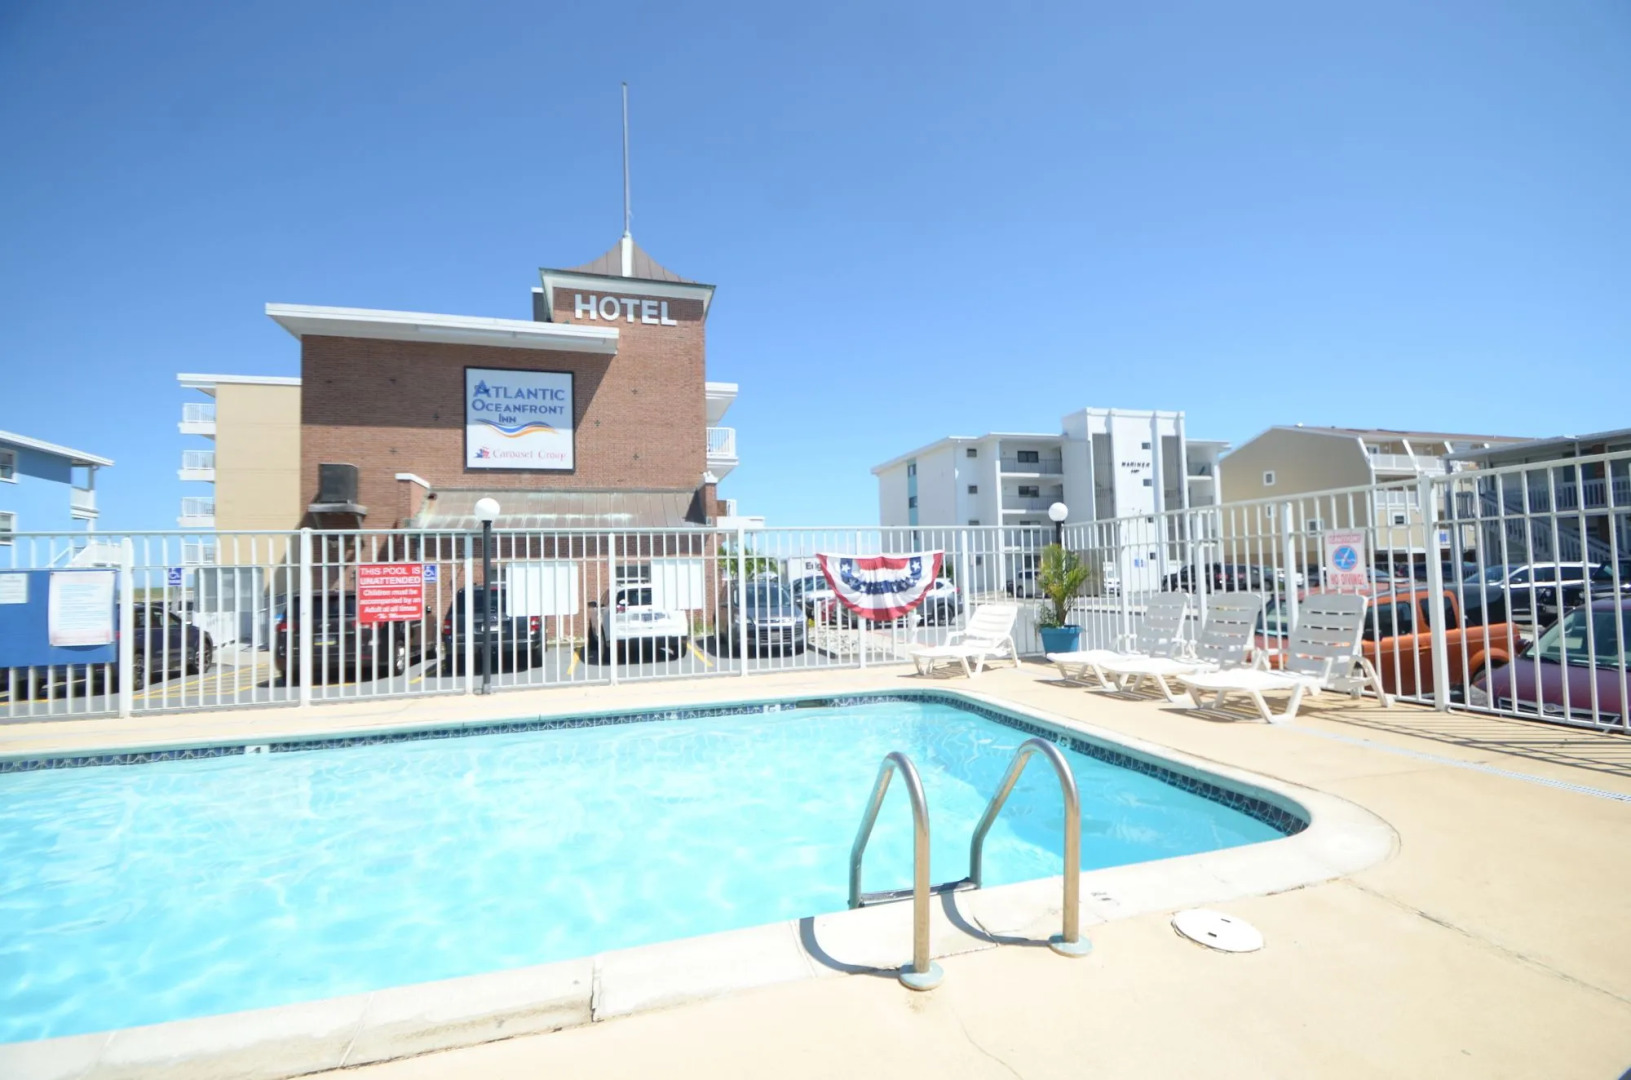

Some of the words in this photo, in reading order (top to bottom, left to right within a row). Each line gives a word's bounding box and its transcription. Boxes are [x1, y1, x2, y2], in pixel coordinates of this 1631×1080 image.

[574, 293, 677, 326] HOTEL
[473, 380, 565, 401] ATLANTIC
[471, 399, 565, 415] OCEANFRONT
[498, 413, 517, 423] INN
[493, 449, 533, 458] Carousel
[538, 450, 566, 461] Group
[361, 567, 381, 575] THIS
[383, 567, 408, 575] POOL
[412, 566, 421, 574] IS
[360, 576, 421, 585] UNATTENDED
[392, 588, 408, 596] must
[403, 597, 412, 605] by
